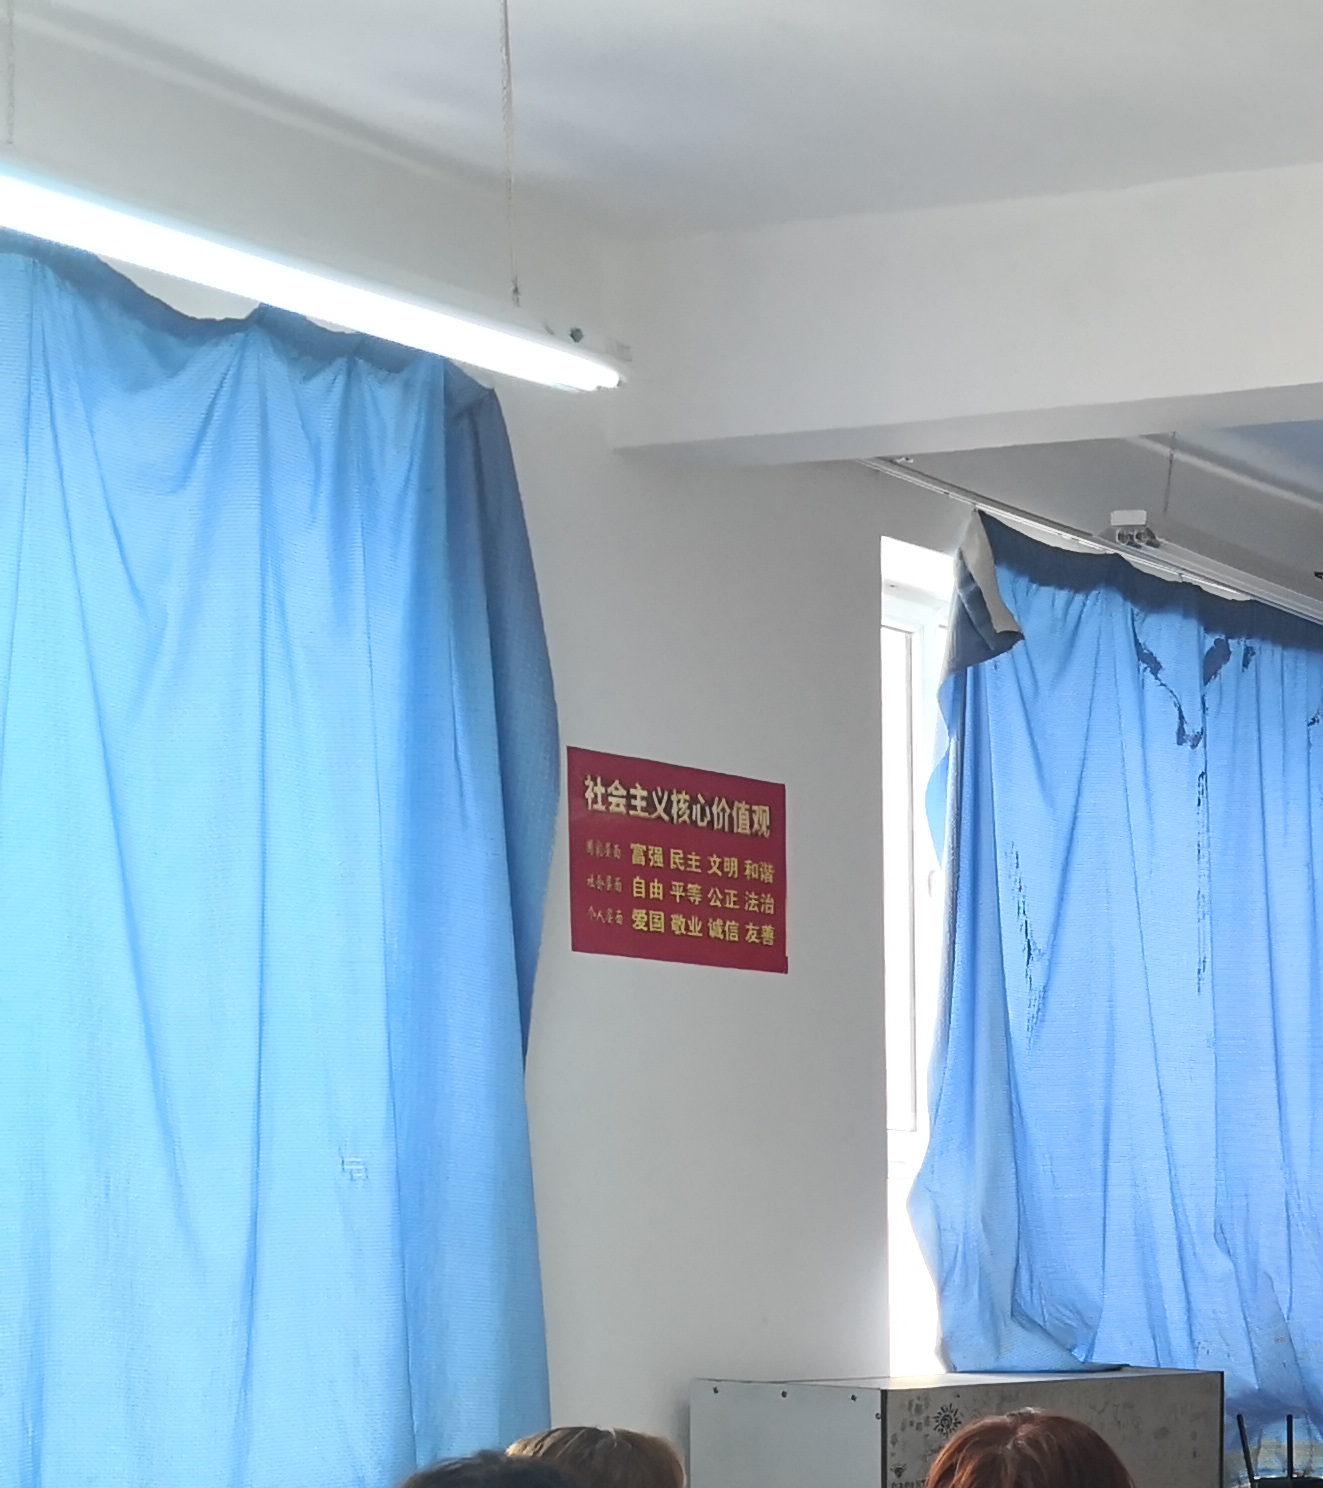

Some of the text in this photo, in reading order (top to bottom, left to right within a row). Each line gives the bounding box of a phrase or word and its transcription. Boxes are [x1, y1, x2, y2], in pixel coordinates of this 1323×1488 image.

[584, 774, 771, 838] 社会主义核心价值观
[630, 843, 664, 868] 富强
[669, 848, 702, 873] 民主
[708, 854, 739, 878] 文明
[744, 860, 774, 883] 和谐
[632, 876, 663, 900] 自由
[669, 881, 702, 905] 平等
[708, 888, 740, 910] 公正
[744, 891, 775, 914] 法治
[632, 909, 665, 932] 爱国
[670, 914, 703, 937] 敬业
[708, 918, 739, 941] 诚信
[745, 923, 775, 946] 友善
